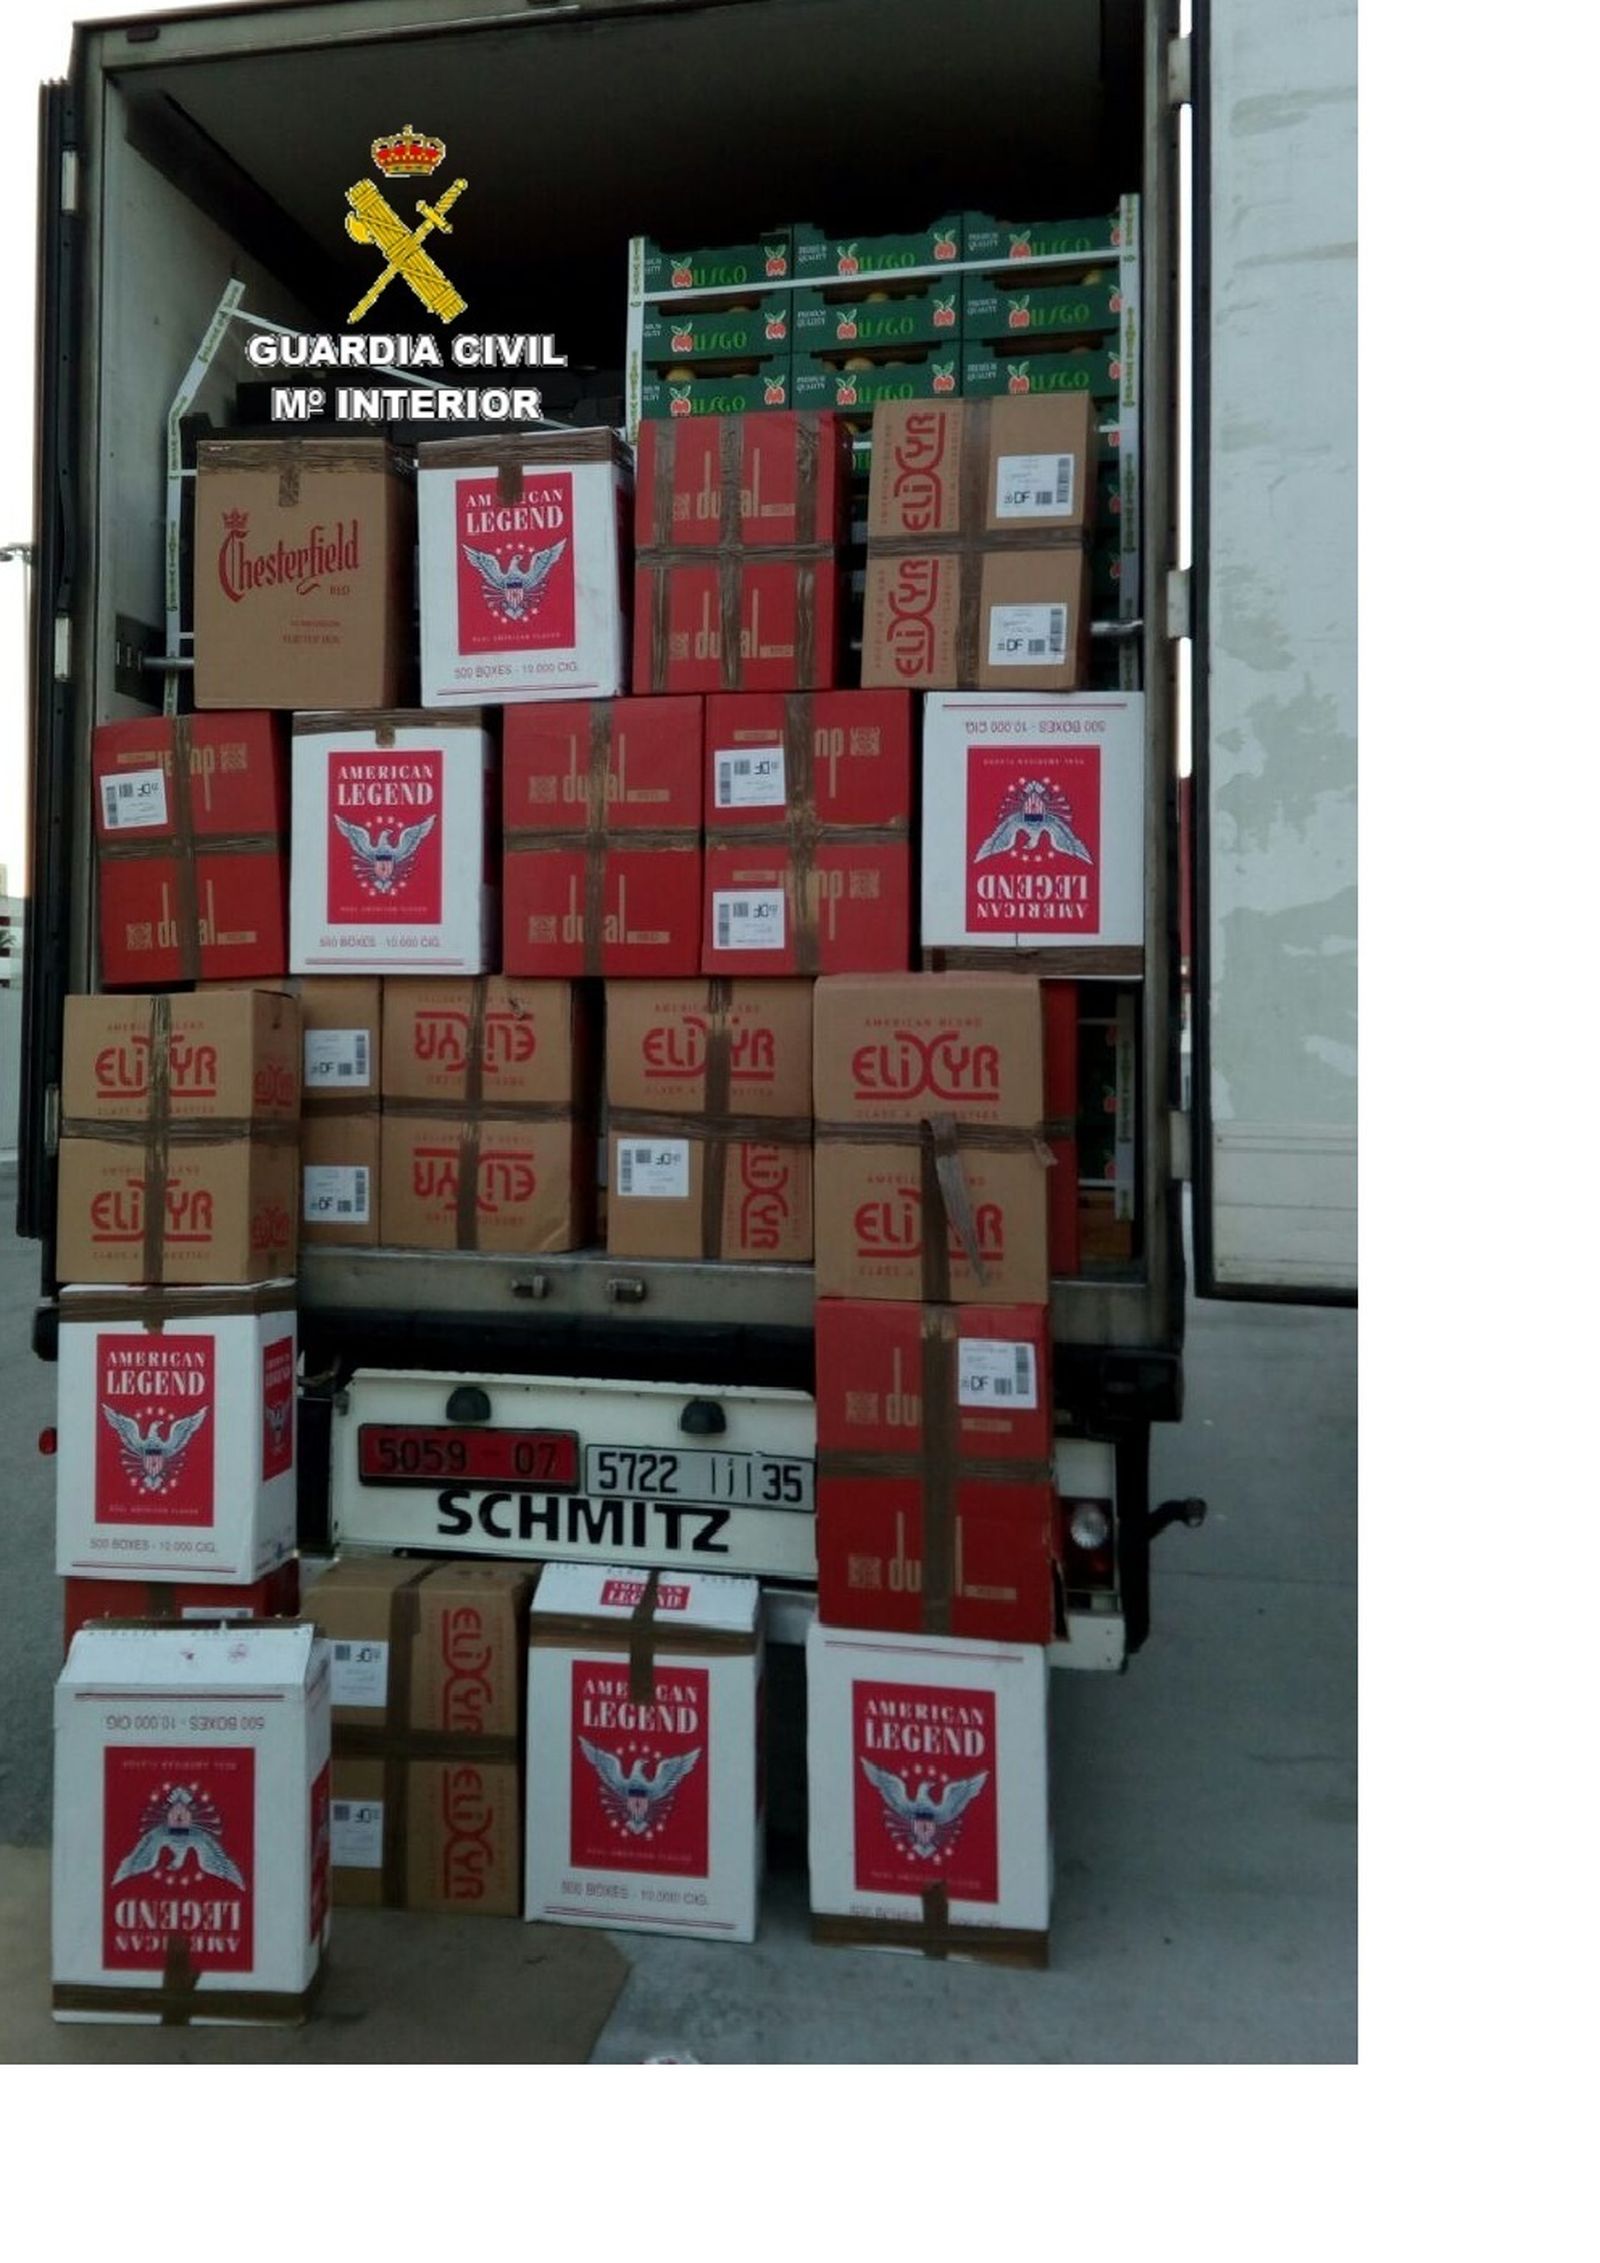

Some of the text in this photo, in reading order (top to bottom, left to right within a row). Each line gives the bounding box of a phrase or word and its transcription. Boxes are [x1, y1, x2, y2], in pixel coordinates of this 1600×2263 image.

[696, 448, 760, 519] dual
[466, 506, 564, 534] LEGEND
[218, 520, 359, 603] Chesterfield
[695, 588, 759, 659] dual
[454, 666, 473, 680] 500
[476, 664, 512, 680] BOXES
[1039, 721, 1081, 734] BOXES
[1084, 720, 1106, 733] 500
[338, 765, 433, 780] AMERICAN
[563, 734, 625, 803] dual
[338, 782, 434, 806] LEGEND
[977, 875, 1089, 899] LEGEND
[158, 879, 215, 948] dual
[563, 875, 625, 943] dual
[976, 903, 1089, 919] AMERICAN
[340, 935, 376, 948] BOXES
[107, 1351, 205, 1367] AMERICAN
[107, 1370, 205, 1396] LEGEND
[378, 1438, 557, 1475] 5059 07
[599, 1452, 679, 1493] 5722
[762, 1463, 802, 1502] 35
[438, 1489, 731, 1553] SCHMITZ
[90, 1538, 108, 1549] 500
[112, 1538, 149, 1551] BOXES
[584, 1679, 697, 1703] AMECAN
[189, 1716, 237, 1730] BOXES
[241, 1716, 264, 1730] 500
[583, 1699, 698, 1734] LEGEND
[865, 1699, 984, 1725] AMERICAN
[865, 1718, 985, 1757] LEGEND
[586, 1882, 629, 1899] BOXES
[114, 1900, 241, 1931] LEGEND
[114, 1935, 241, 1953] AMEICAN
